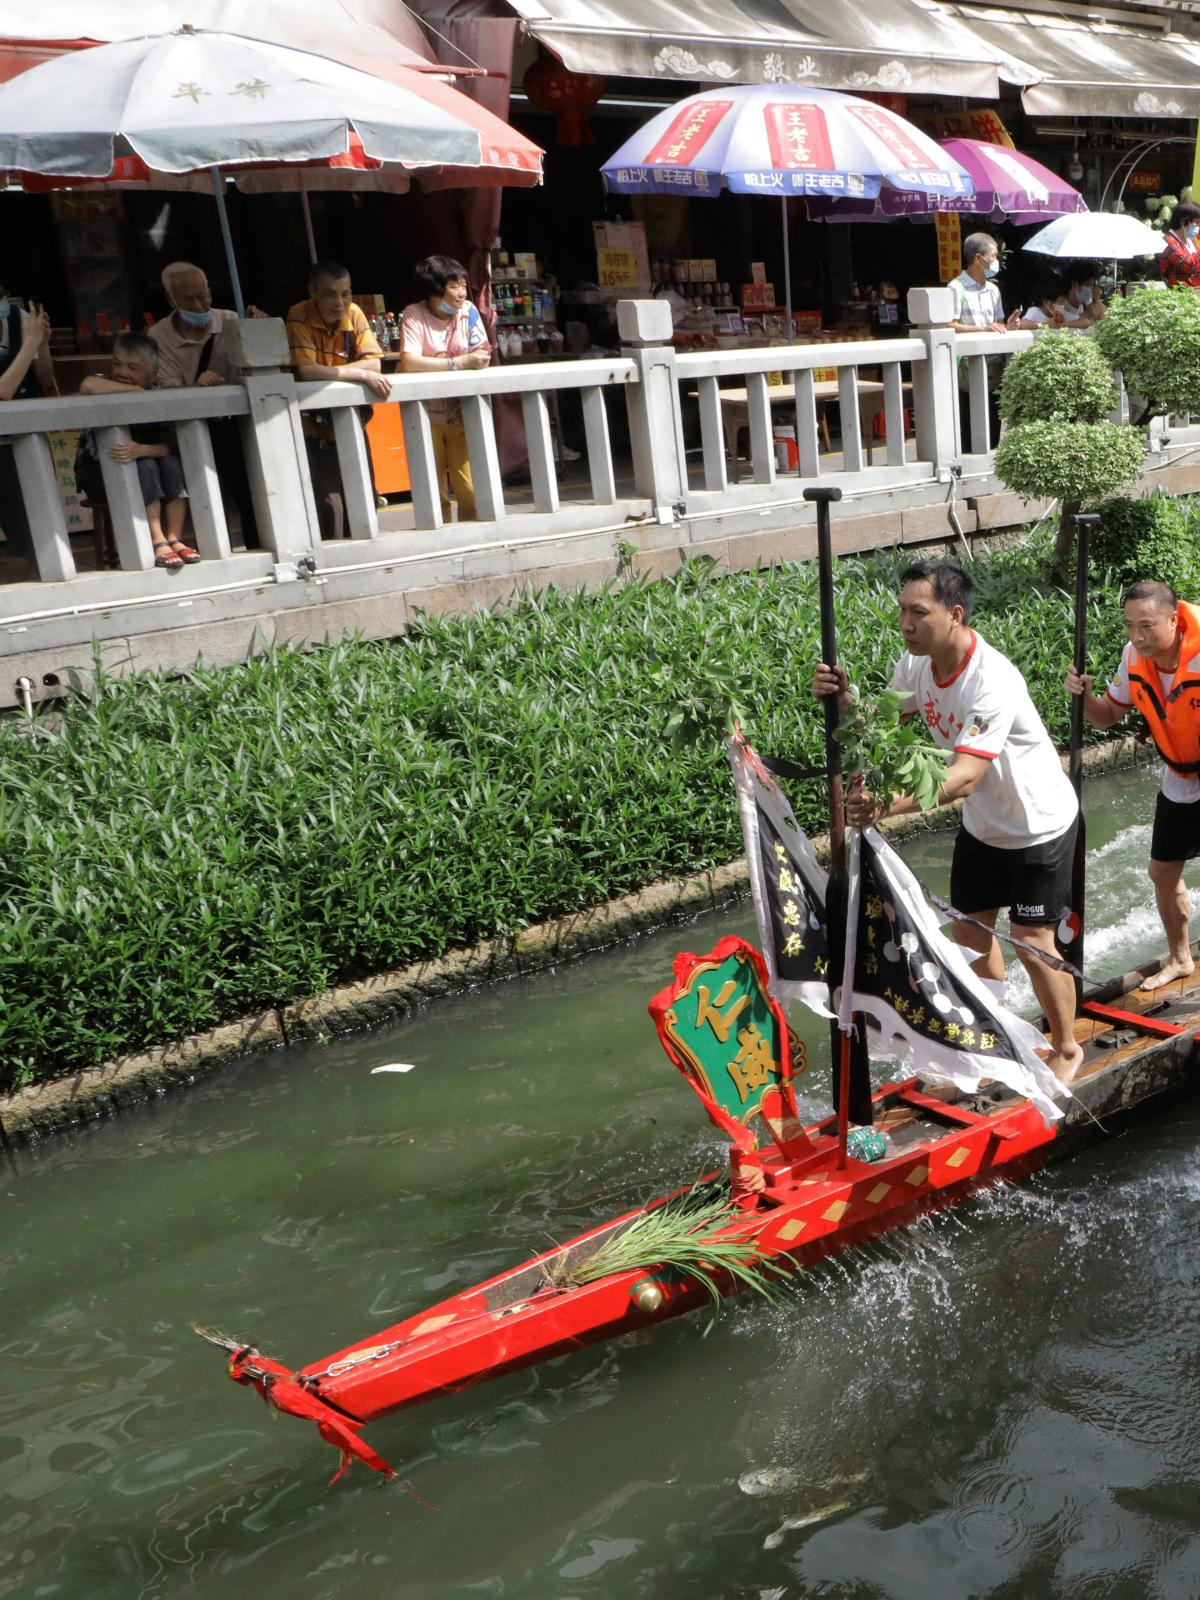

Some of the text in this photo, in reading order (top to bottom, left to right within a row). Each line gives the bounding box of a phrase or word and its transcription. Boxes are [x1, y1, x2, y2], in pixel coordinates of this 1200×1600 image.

[667, 108, 711, 158] 王老吉
[787, 111, 812, 162] 王老吉
[744, 173, 784, 188] 怕上火
[1017, 904, 1045, 913] V-OGUE
[695, 980, 783, 1104] 仁威
